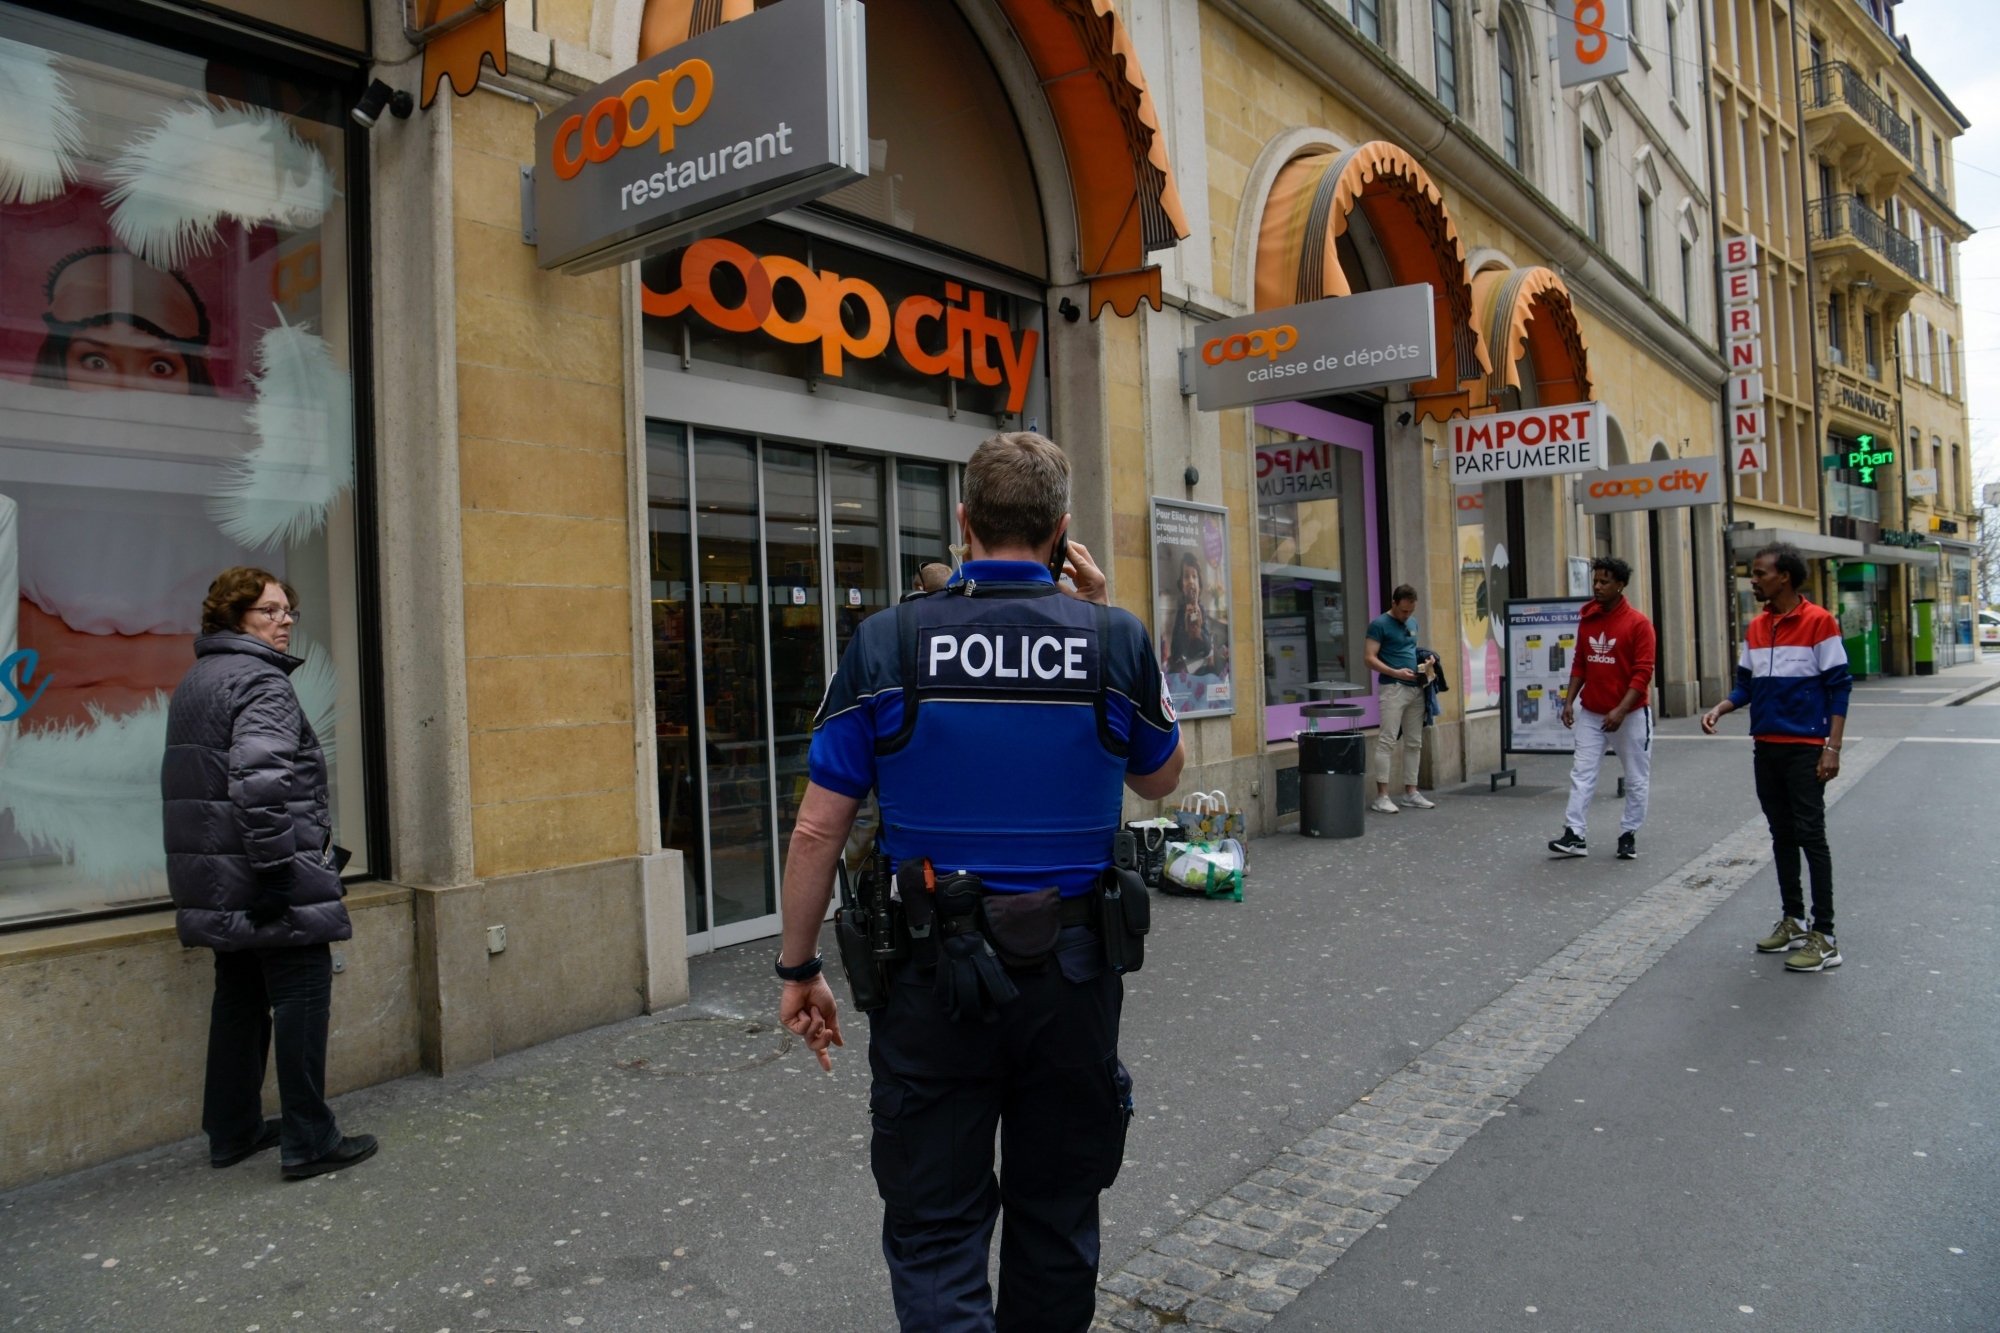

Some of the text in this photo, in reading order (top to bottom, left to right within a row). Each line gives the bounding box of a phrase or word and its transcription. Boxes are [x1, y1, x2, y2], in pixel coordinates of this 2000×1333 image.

[553, 58, 713, 180] coop
[620, 122, 794, 211] restaurant
[894, 281, 1039, 414] city
[1201, 324, 1298, 366] coop
[1247, 342, 1420, 383] caisse de dépôts
[1728, 240, 1759, 470] BERNINA
[1842, 387, 1888, 421] PHARMACIE
[1455, 410, 1591, 453] IMPORT
[1455, 441, 1591, 475] PARFUMERIE
[1589, 468, 1708, 499] coop city
[1156, 509, 1199, 524] Pour Elias, qui
[1156, 523, 1199, 535] croque la vie à
[1156, 534, 1198, 546] pleines dents.
[1511, 615, 1549, 623] FESTIVAL
[1551, 614, 1568, 622] DES
[929, 633, 1088, 680] POLICE
[1588, 654, 1615, 665] adidas
